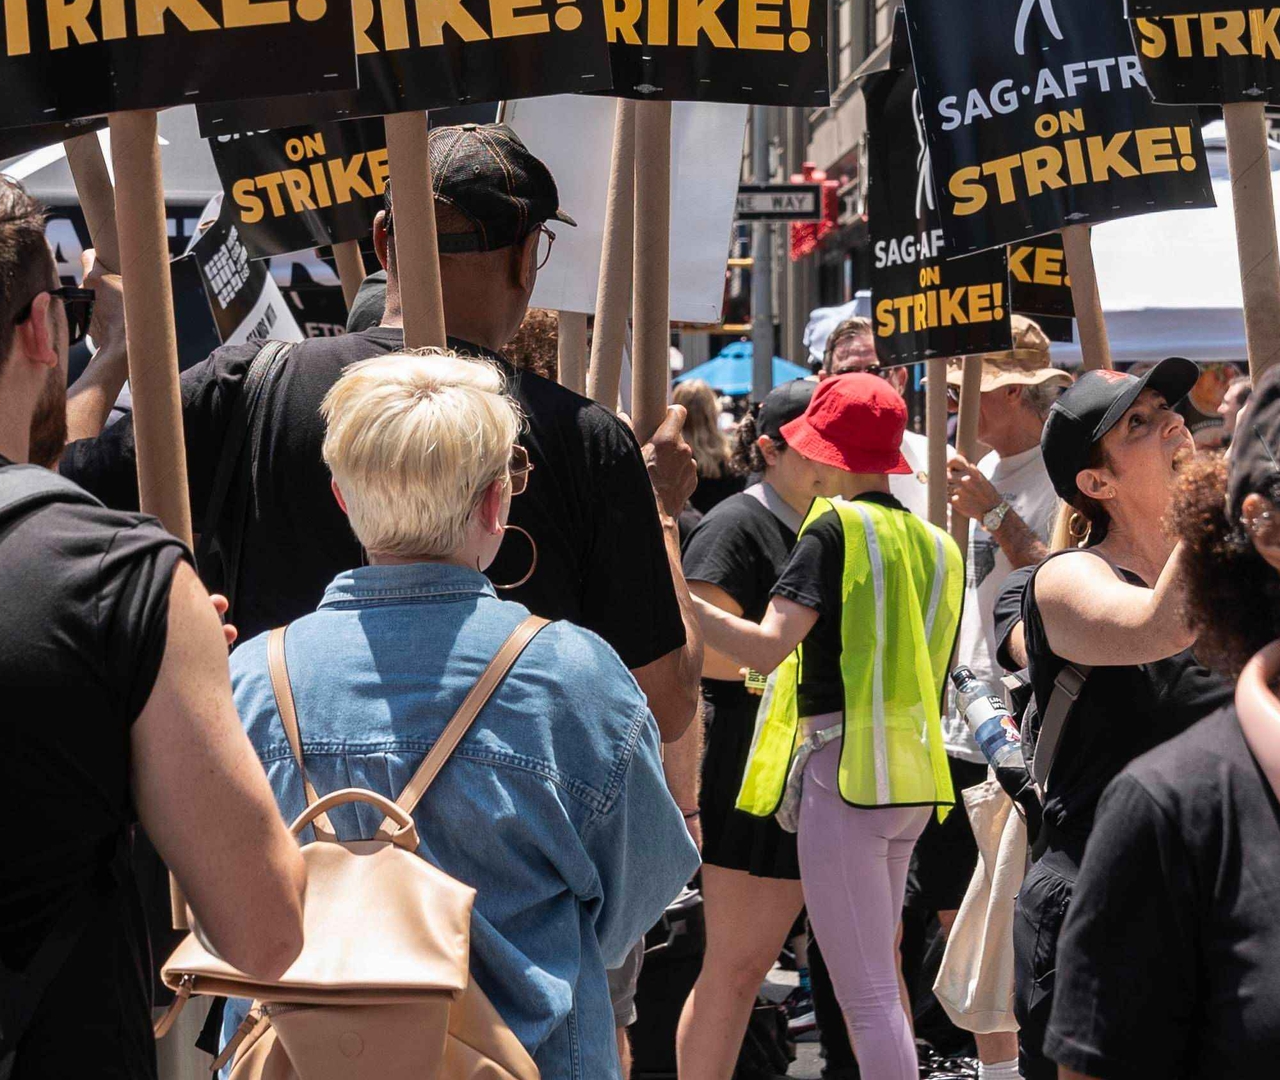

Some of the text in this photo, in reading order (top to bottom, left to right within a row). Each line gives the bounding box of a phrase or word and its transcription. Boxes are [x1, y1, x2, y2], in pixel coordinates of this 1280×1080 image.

[1034, 108, 1085, 139] ON
[285, 132, 326, 162] ON
[948, 126, 1197, 216] STRIKE!
[771, 195, 806, 211] WAY
[919, 266, 941, 288] ON
[876, 282, 1004, 338] STRIKE!
